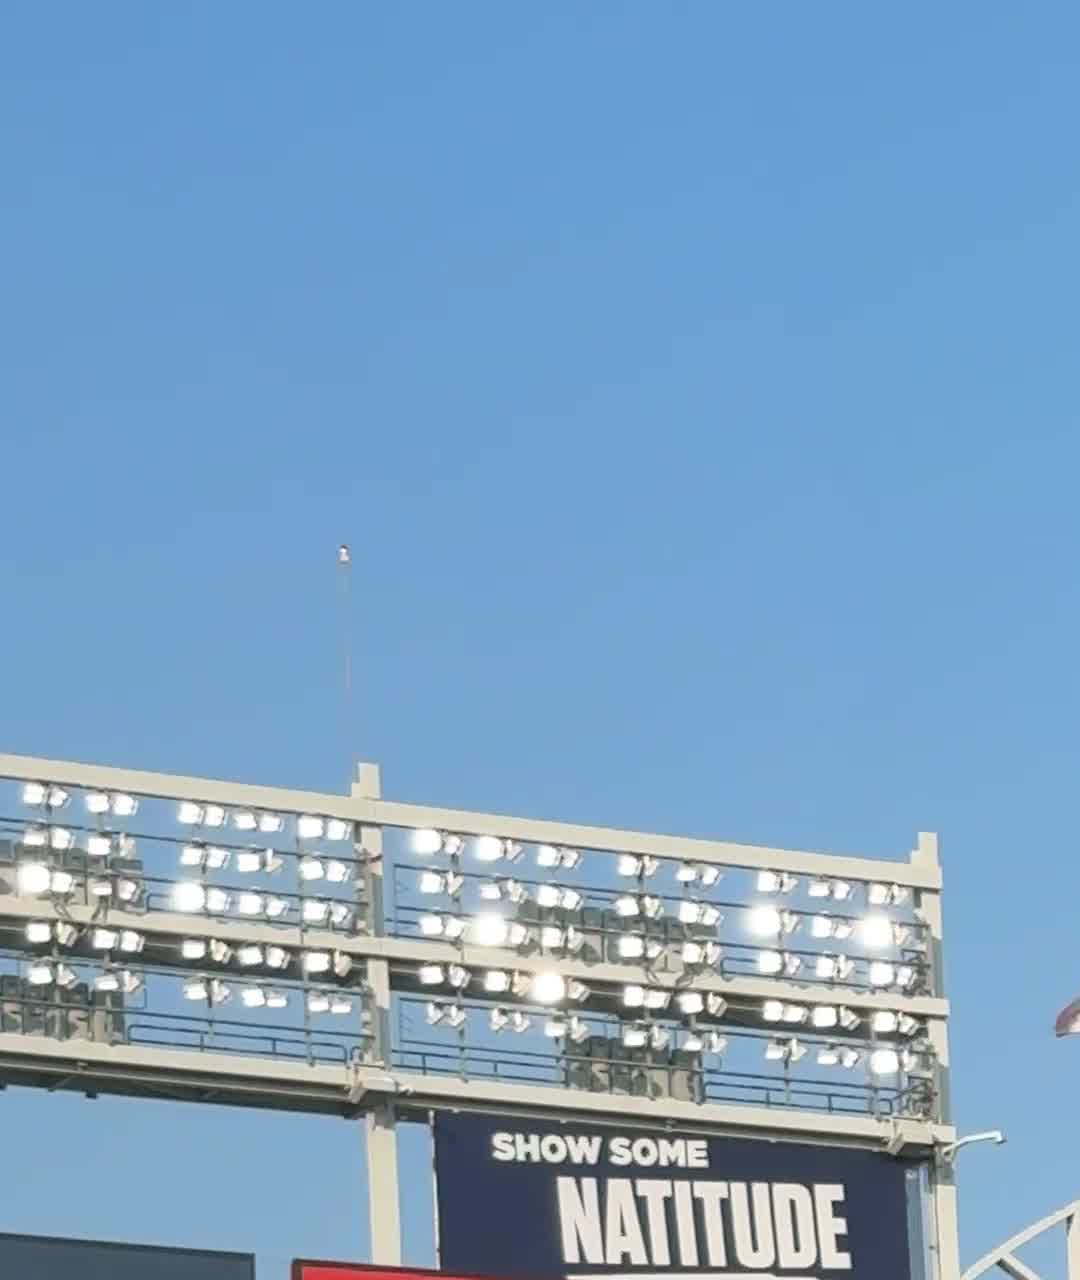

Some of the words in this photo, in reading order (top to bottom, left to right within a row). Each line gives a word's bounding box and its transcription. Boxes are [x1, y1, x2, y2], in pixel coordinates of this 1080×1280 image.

[491, 1132, 601, 1165] SHOW
[609, 1137, 709, 1168] SOME
[556, 1176, 853, 1269] NATITUDE
